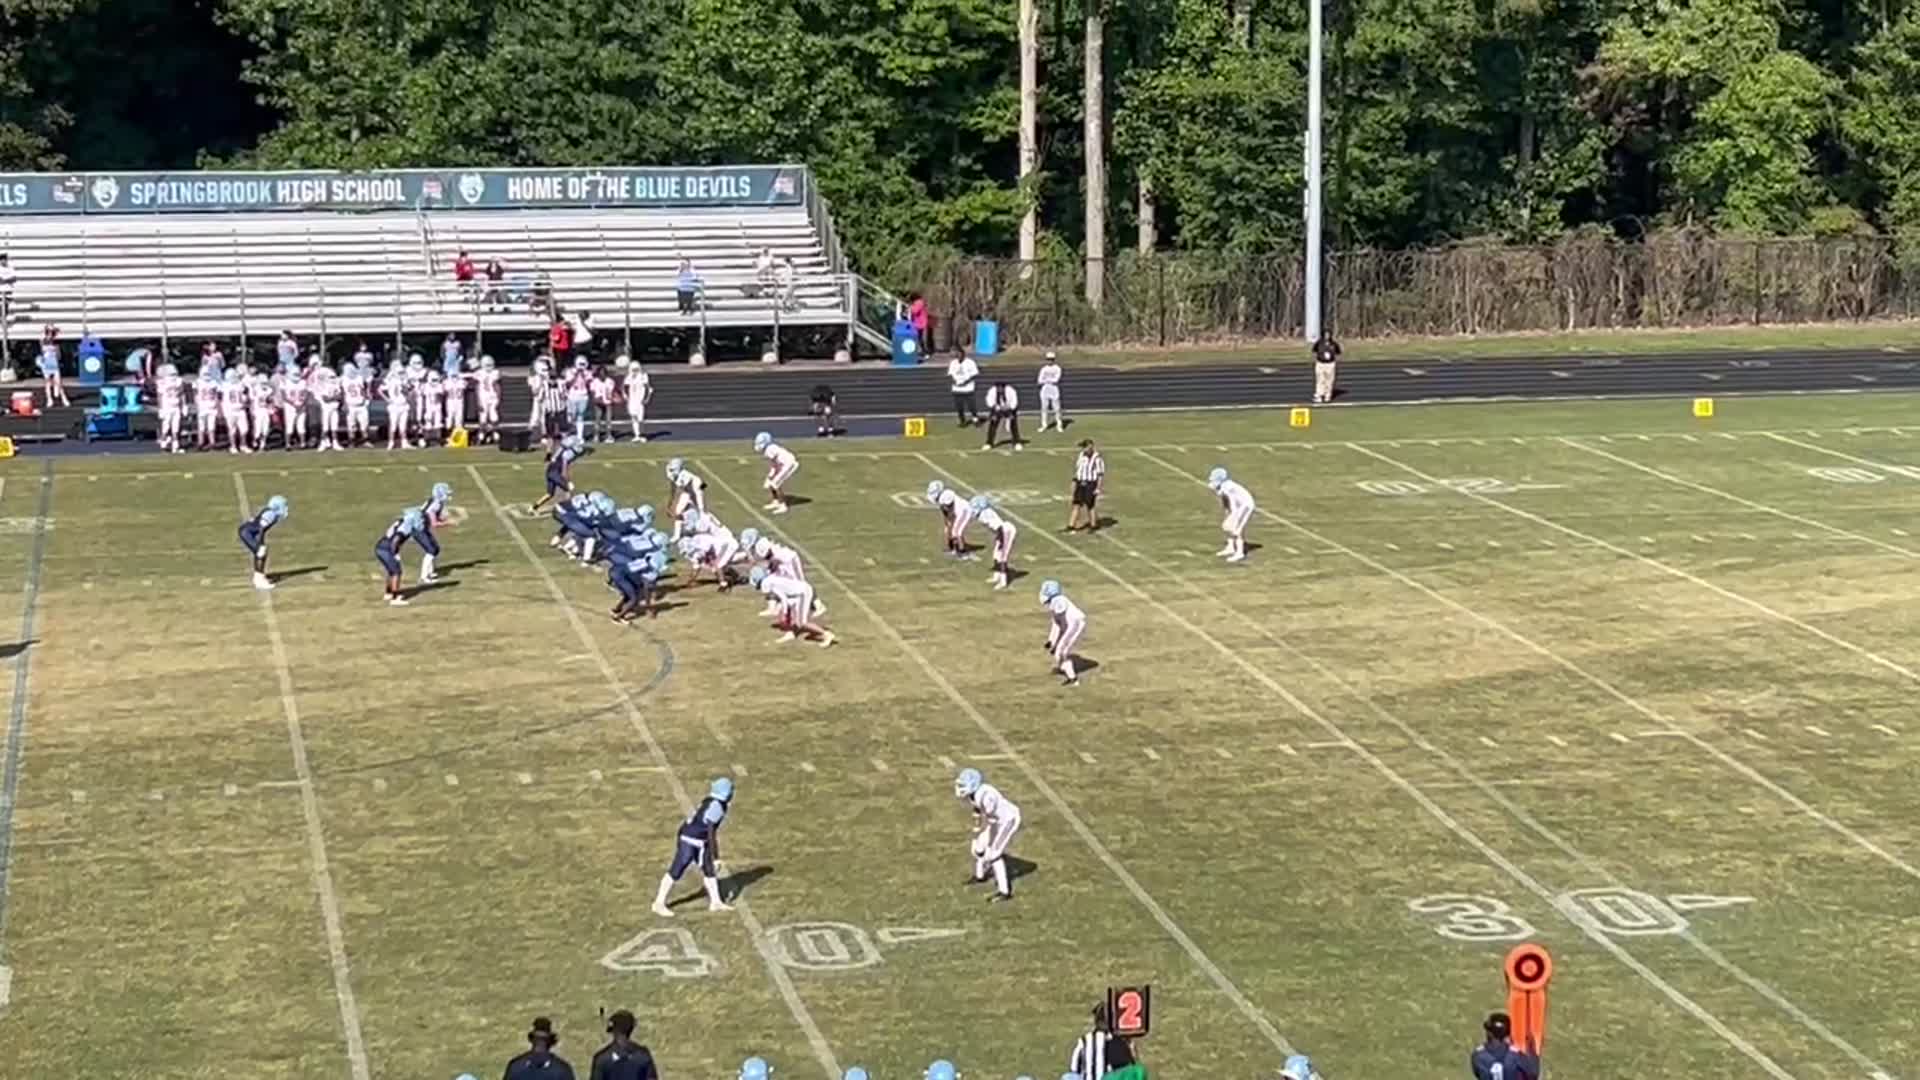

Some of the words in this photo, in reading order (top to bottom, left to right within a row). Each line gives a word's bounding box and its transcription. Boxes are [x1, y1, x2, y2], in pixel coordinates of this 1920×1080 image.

[130, 180, 273, 205] SPRINGBROOK
[277, 179, 326, 203] HIGH
[331, 177, 407, 202] SCHOOL
[508, 176, 563, 200] HOME
[567, 176, 591, 200] OF
[595, 175, 631, 199] THE
[635, 175, 681, 199] BLUE
[685, 175, 751, 199] DEVILS
[1118, 991, 1142, 1029] 2
